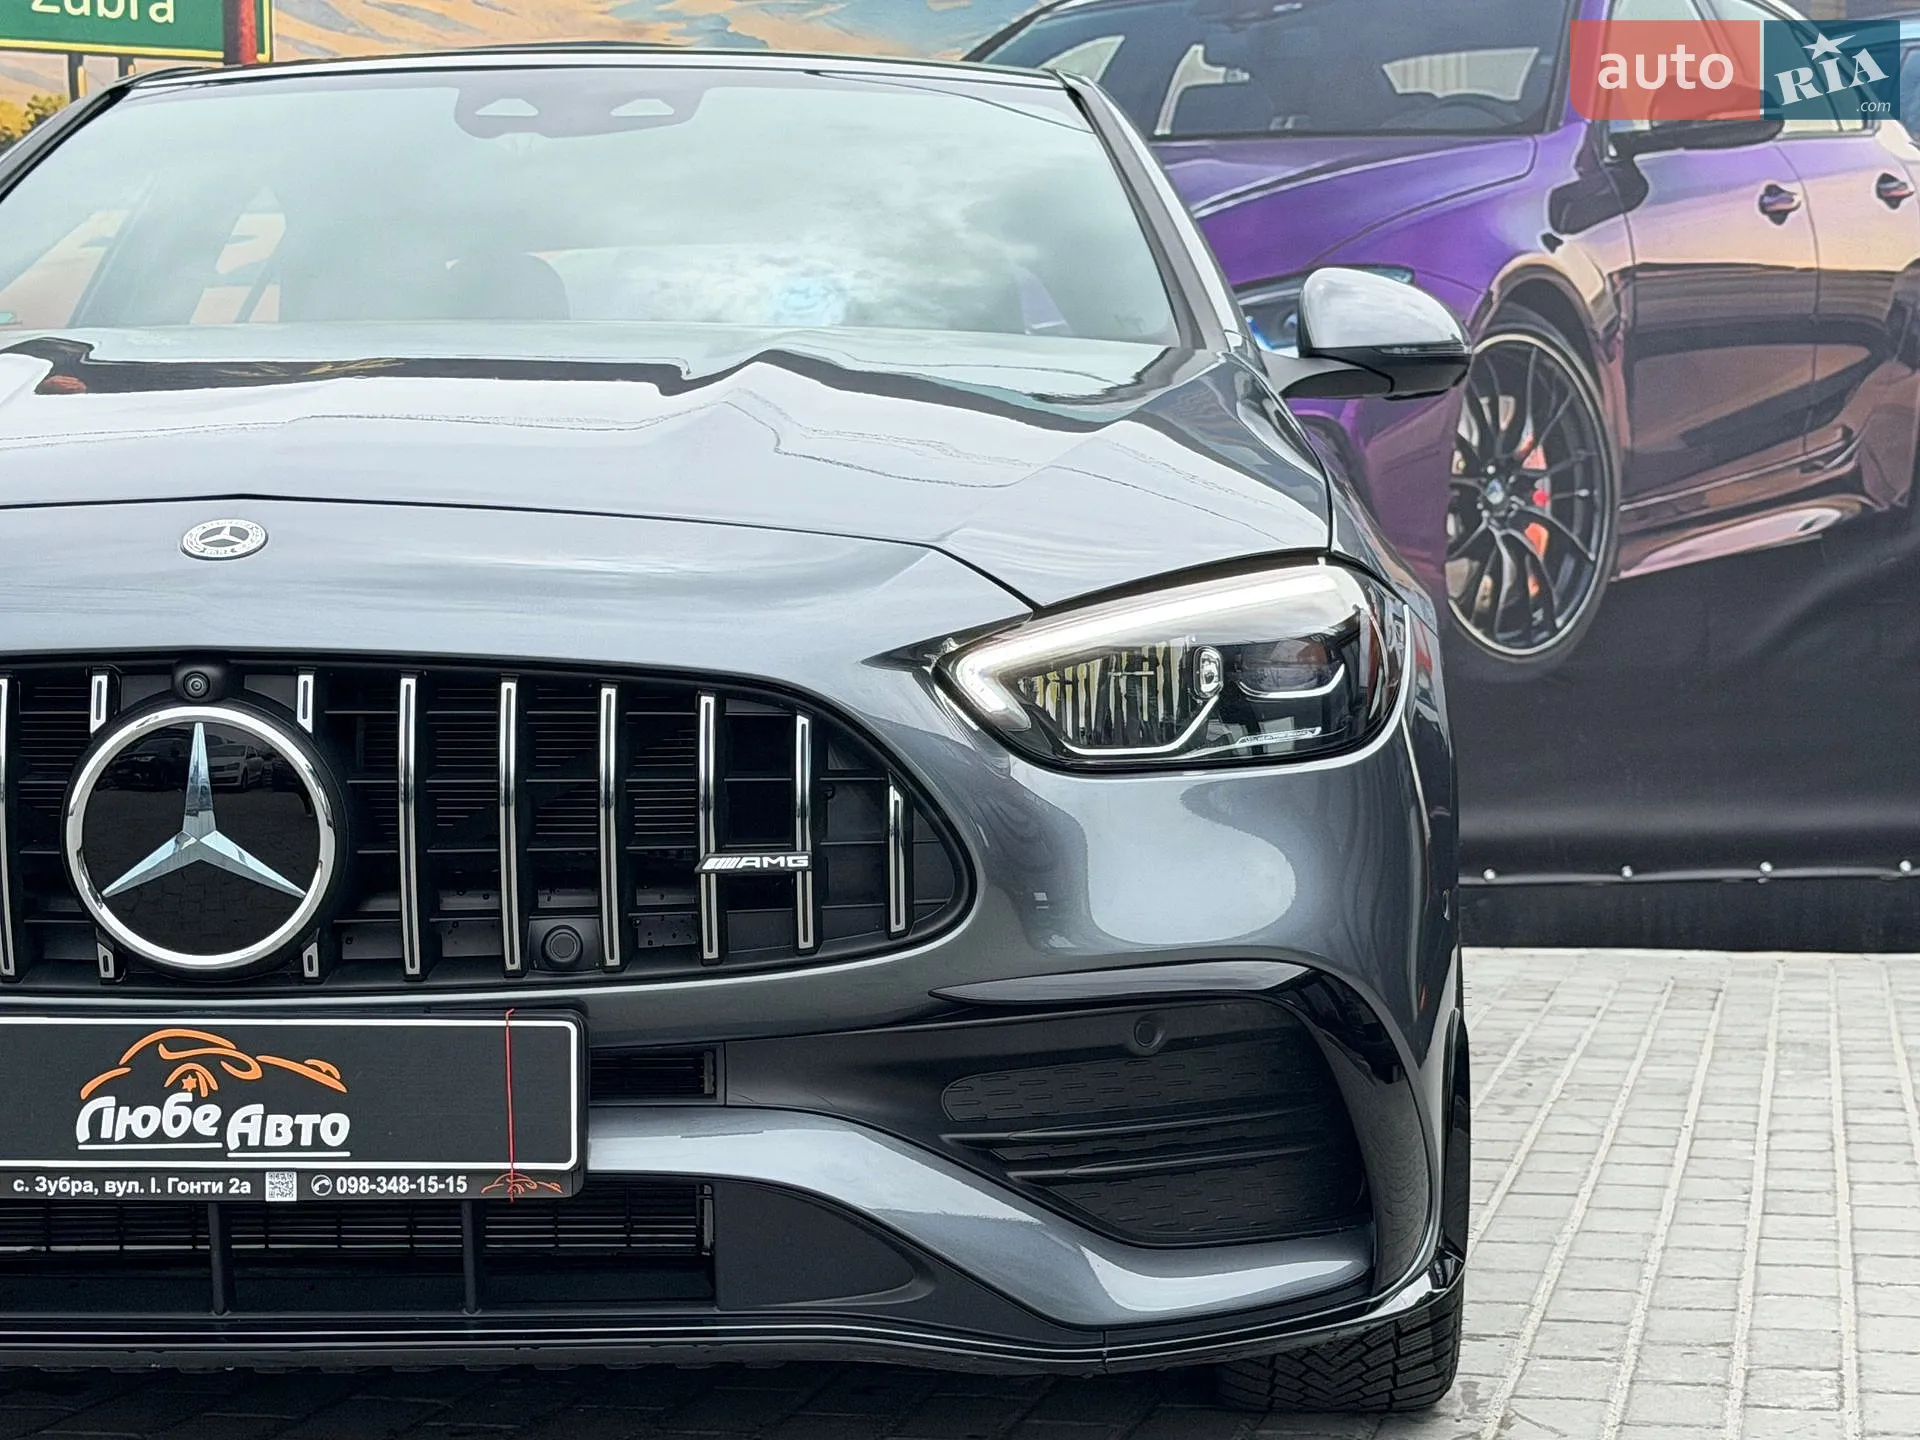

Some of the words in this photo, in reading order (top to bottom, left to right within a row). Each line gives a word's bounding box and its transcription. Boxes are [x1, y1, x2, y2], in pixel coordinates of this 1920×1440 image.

[736, 855, 809, 869] AMG
[75, 1092, 222, 1143] Любе
[226, 1103, 351, 1151] Авто
[13, 1179, 30, 1192] с.
[35, 1176, 99, 1197] Зубра,
[104, 1180, 145, 1197] вул.
[167, 1177, 224, 1194] Гонти
[228, 1177, 251, 1194] 2а
[336, 1175, 468, 1194] 098-348-15-15
